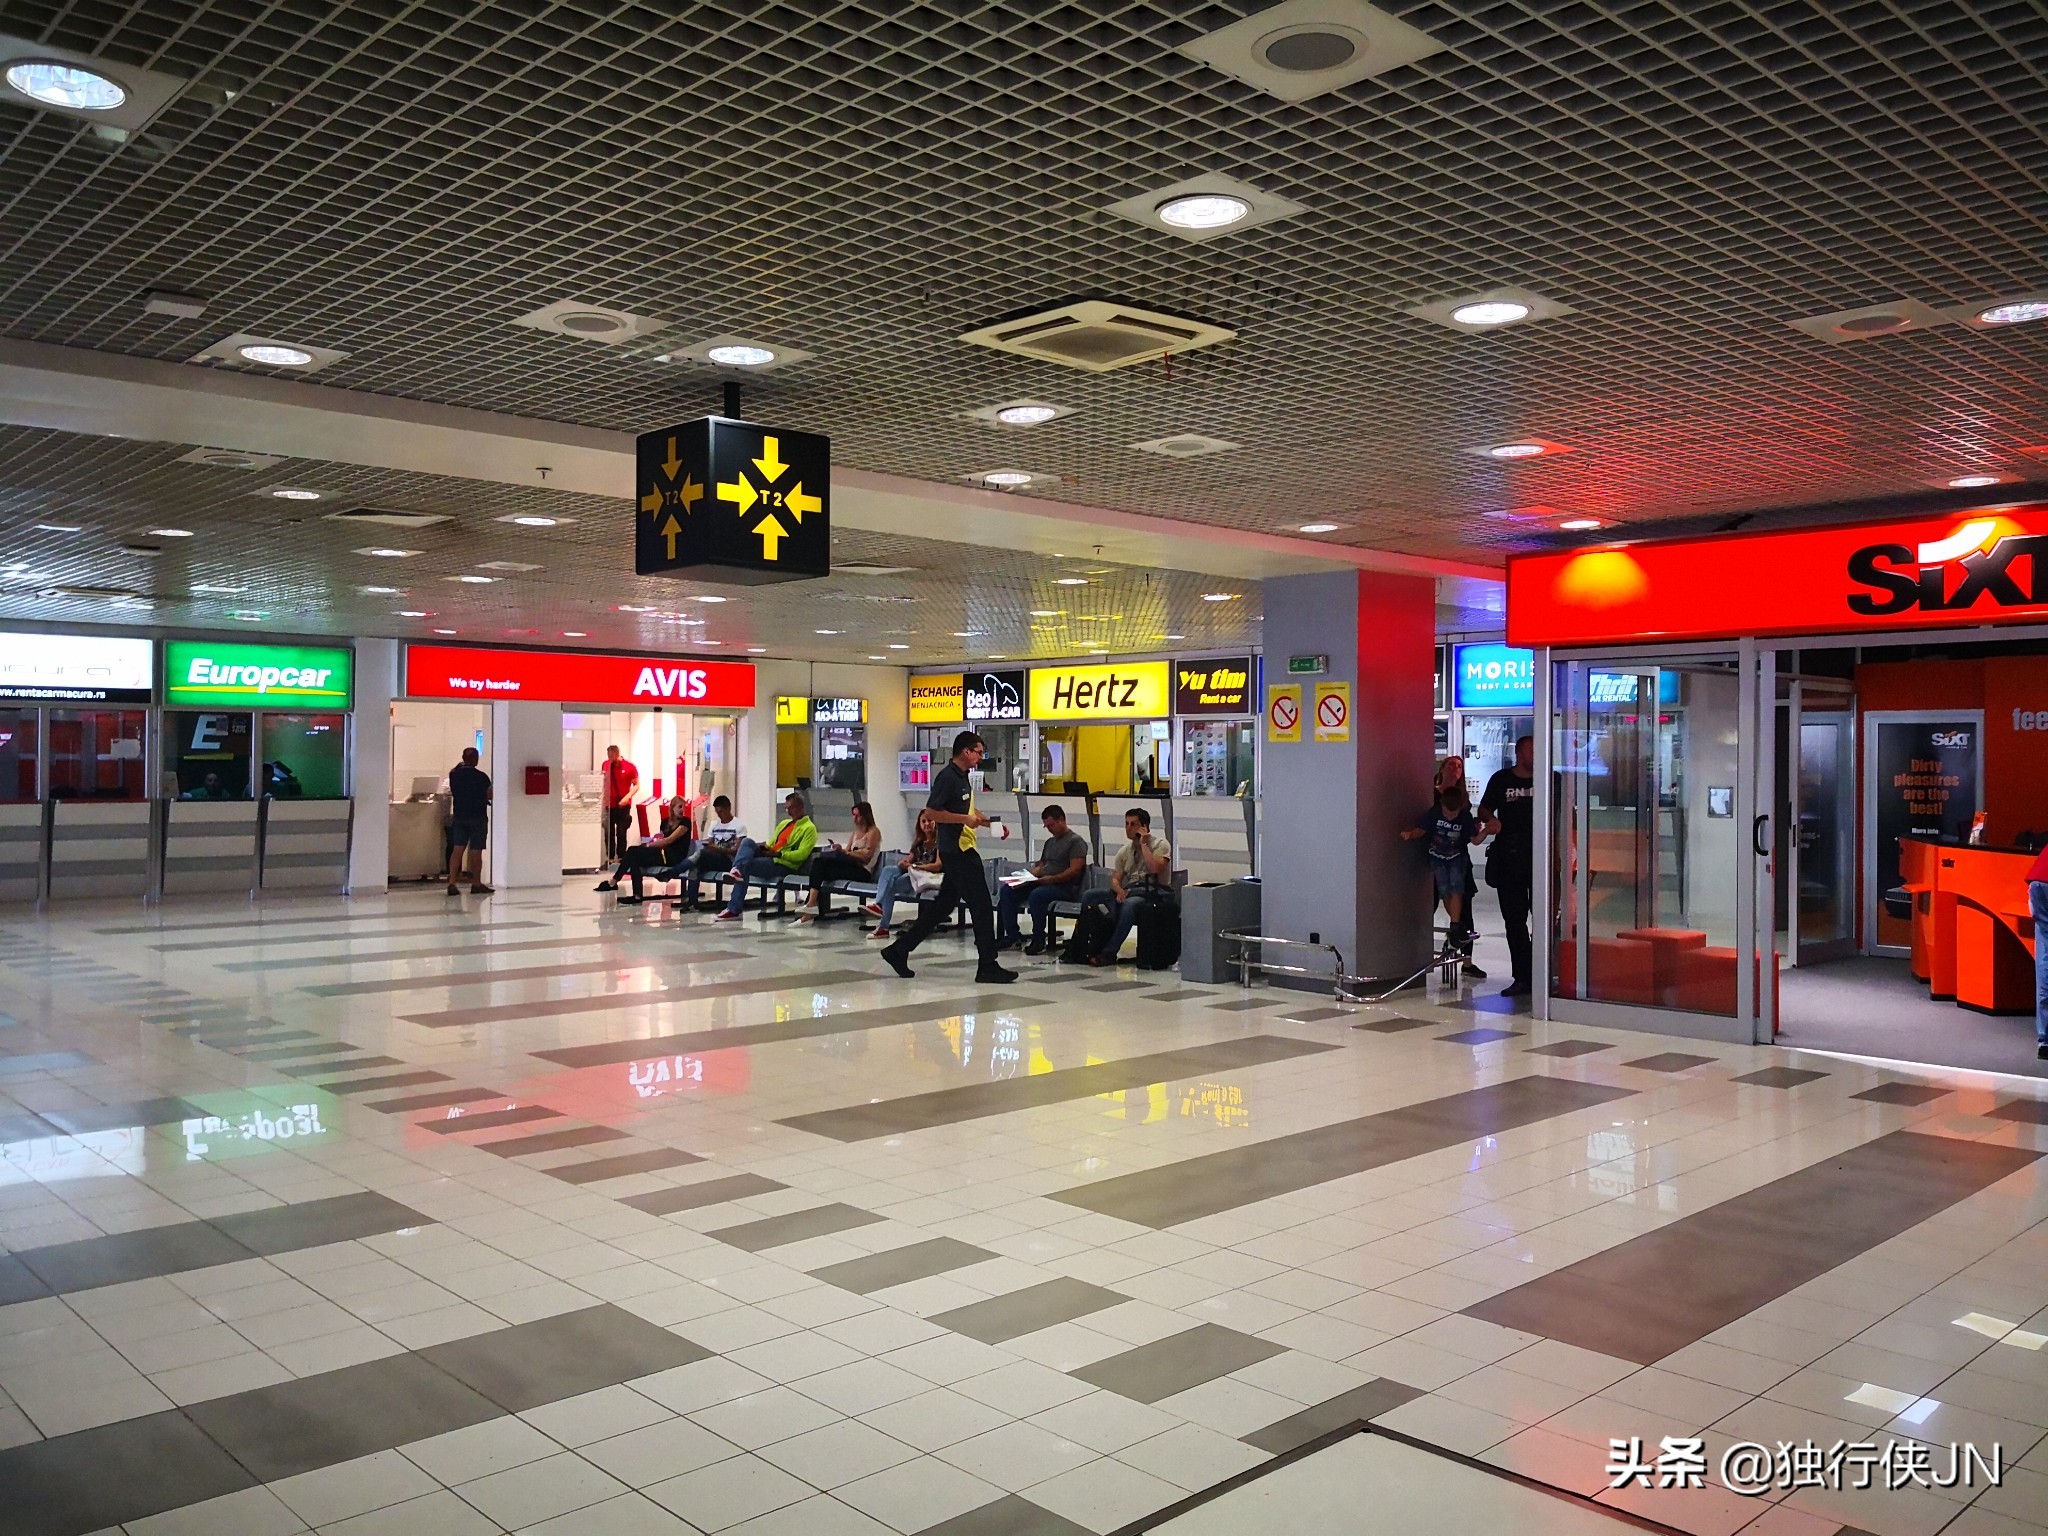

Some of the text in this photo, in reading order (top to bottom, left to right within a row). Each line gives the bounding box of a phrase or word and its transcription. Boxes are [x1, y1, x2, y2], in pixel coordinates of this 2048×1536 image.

[188, 657, 332, 694] Europcar
[633, 667, 707, 698] AVIS
[1179, 668, 1246, 690] Yu tim
[449, 677, 520, 691] We try harder
[911, 686, 963, 698] EXCHANGE
[966, 689, 992, 708] Beo
[1053, 673, 1139, 710] Hertz
[1200, 694, 1219, 704] Rent
[1228, 694, 1242, 704] car
[1911, 759, 1943, 773] Dirty
[1893, 774, 1960, 788] pleasures
[1903, 788, 1950, 800] are the
[1910, 802, 1943, 815] best!
